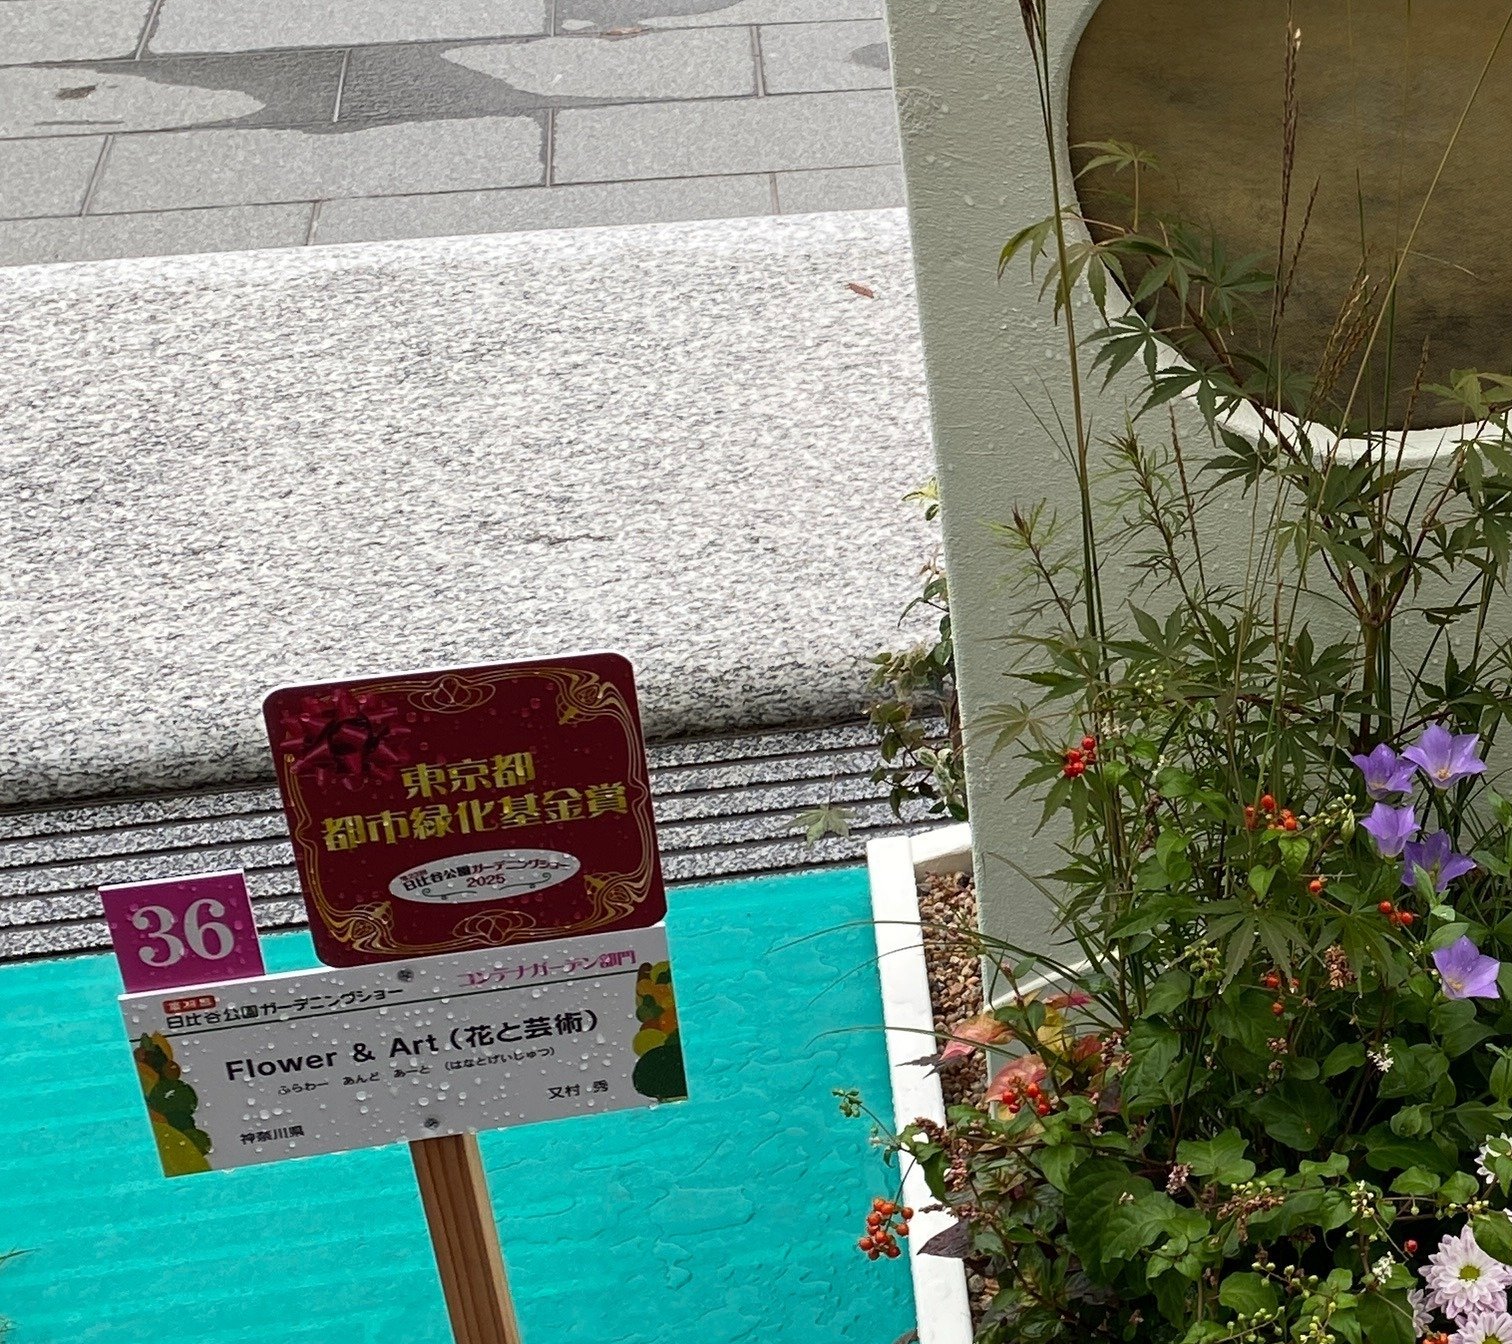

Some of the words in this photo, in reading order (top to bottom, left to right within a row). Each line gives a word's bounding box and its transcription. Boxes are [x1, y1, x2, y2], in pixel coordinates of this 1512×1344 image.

[401, 752, 536, 800] 東京都
[321, 781, 628, 852] 都市緑化基金賞
[466, 873, 506, 888] 2025
[132, 898, 234, 967] 36
[457, 950, 637, 988] コンテナガーデン部門
[166, 987, 404, 1030] 日比谷公園ガーデニングショー
[225, 1051, 338, 1081] Flower
[353, 1043, 376, 1063] &
[389, 1033, 439, 1059] Art
[278, 1081, 329, 1096] ふらわー
[343, 1071, 381, 1086] あんど
[393, 1064, 431, 1079] あーと
[548, 1083, 581, 1100] 又村
[239, 1125, 306, 1147] 神奈川県
